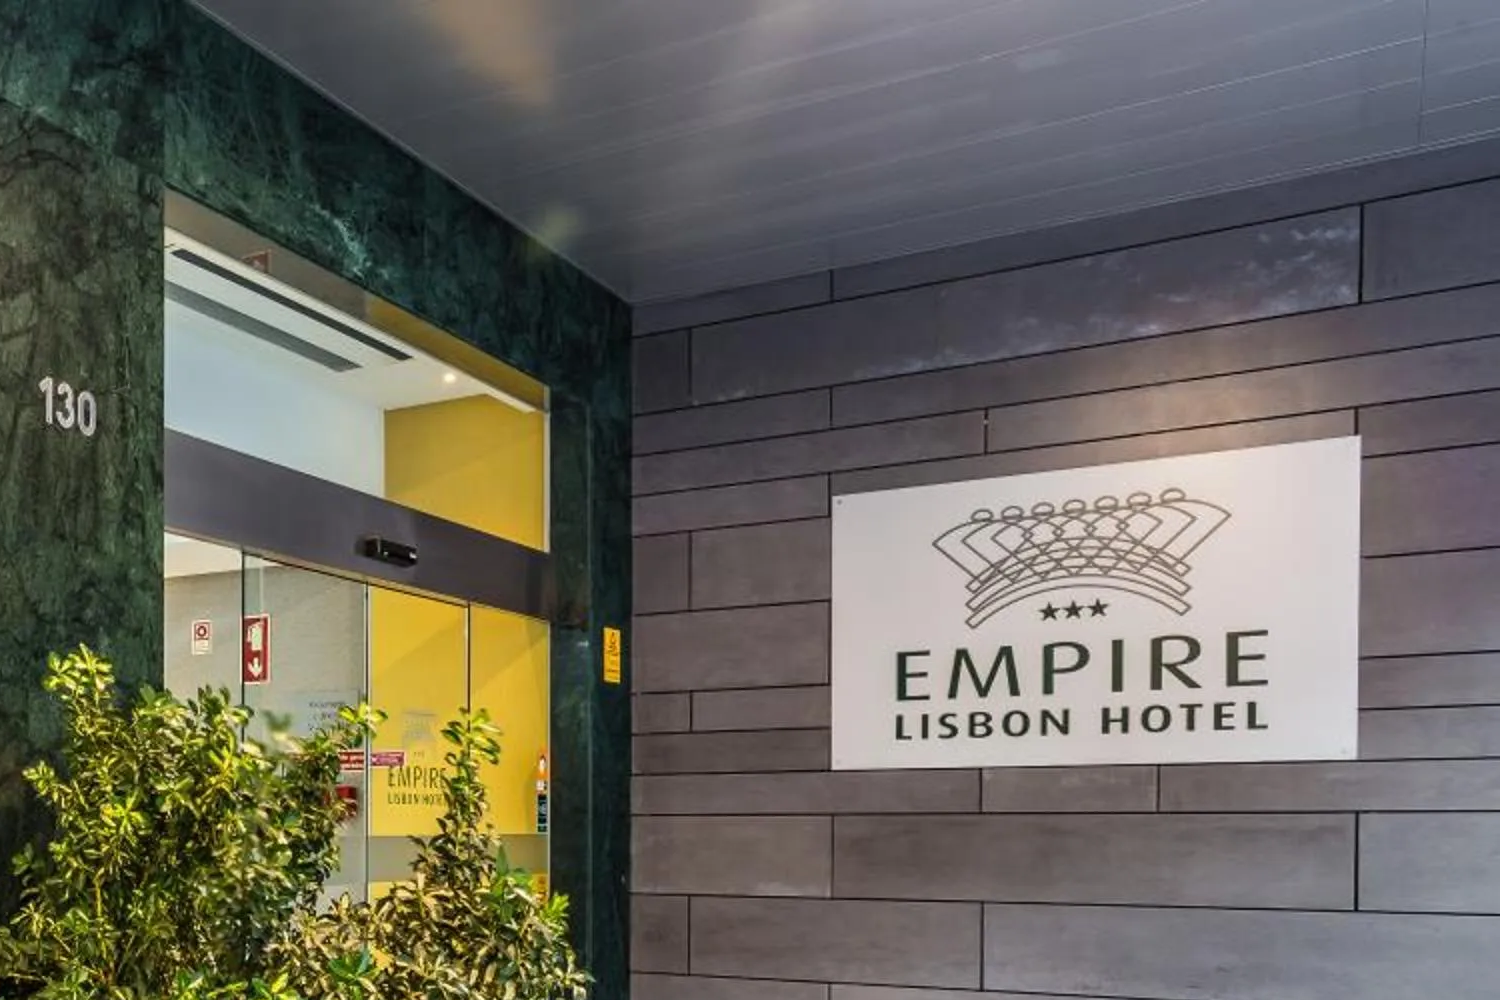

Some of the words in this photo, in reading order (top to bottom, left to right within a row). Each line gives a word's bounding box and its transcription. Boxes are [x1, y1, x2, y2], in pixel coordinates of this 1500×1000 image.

[39, 376, 97, 436] 130
[895, 629, 1269, 701] EMPIRE
[895, 708, 1070, 740] LISBON
[1101, 702, 1269, 735] HOTEL
